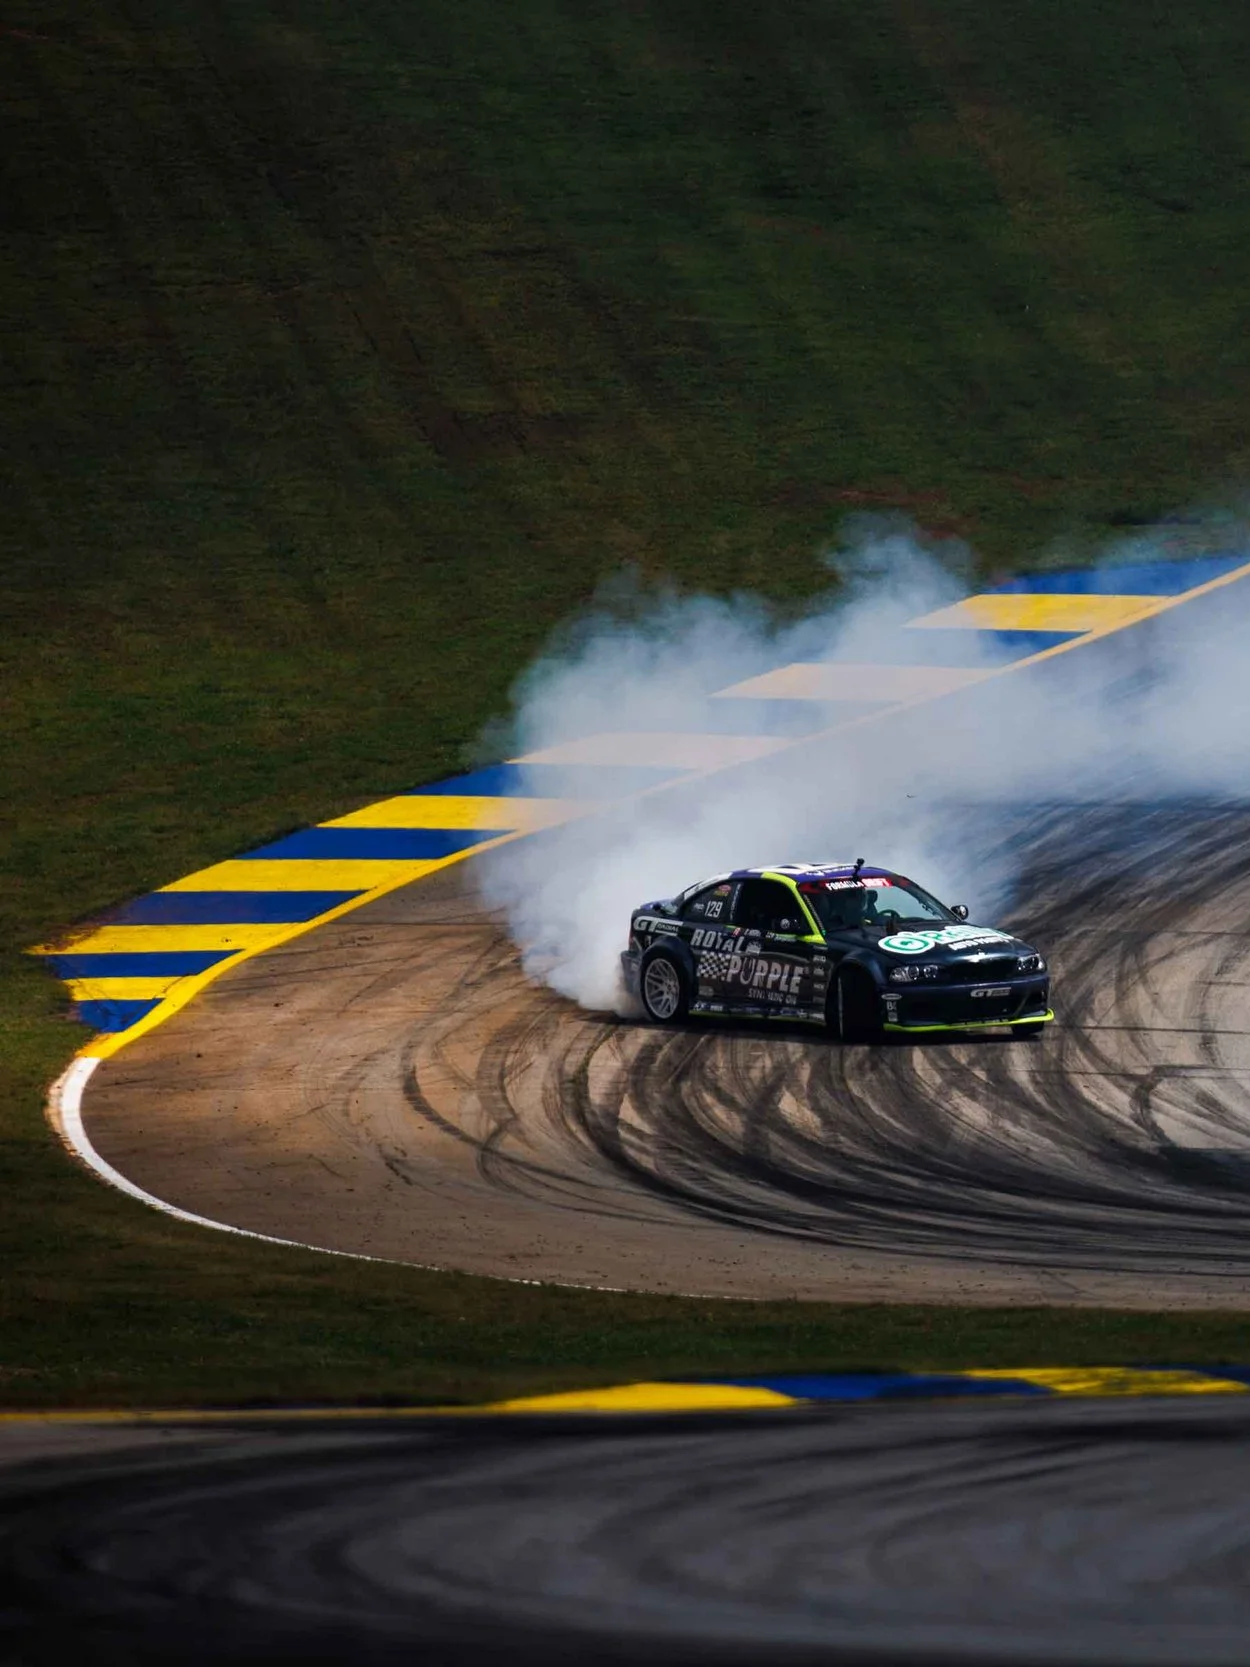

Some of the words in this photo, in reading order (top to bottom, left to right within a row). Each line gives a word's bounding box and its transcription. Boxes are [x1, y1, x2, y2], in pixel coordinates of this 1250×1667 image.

[825, 880, 865, 891] FORMULA
[704, 900, 723, 918] 129
[633, 915, 662, 933] GT
[690, 928, 744, 953] ROYAL
[726, 954, 804, 994] PURPLE
